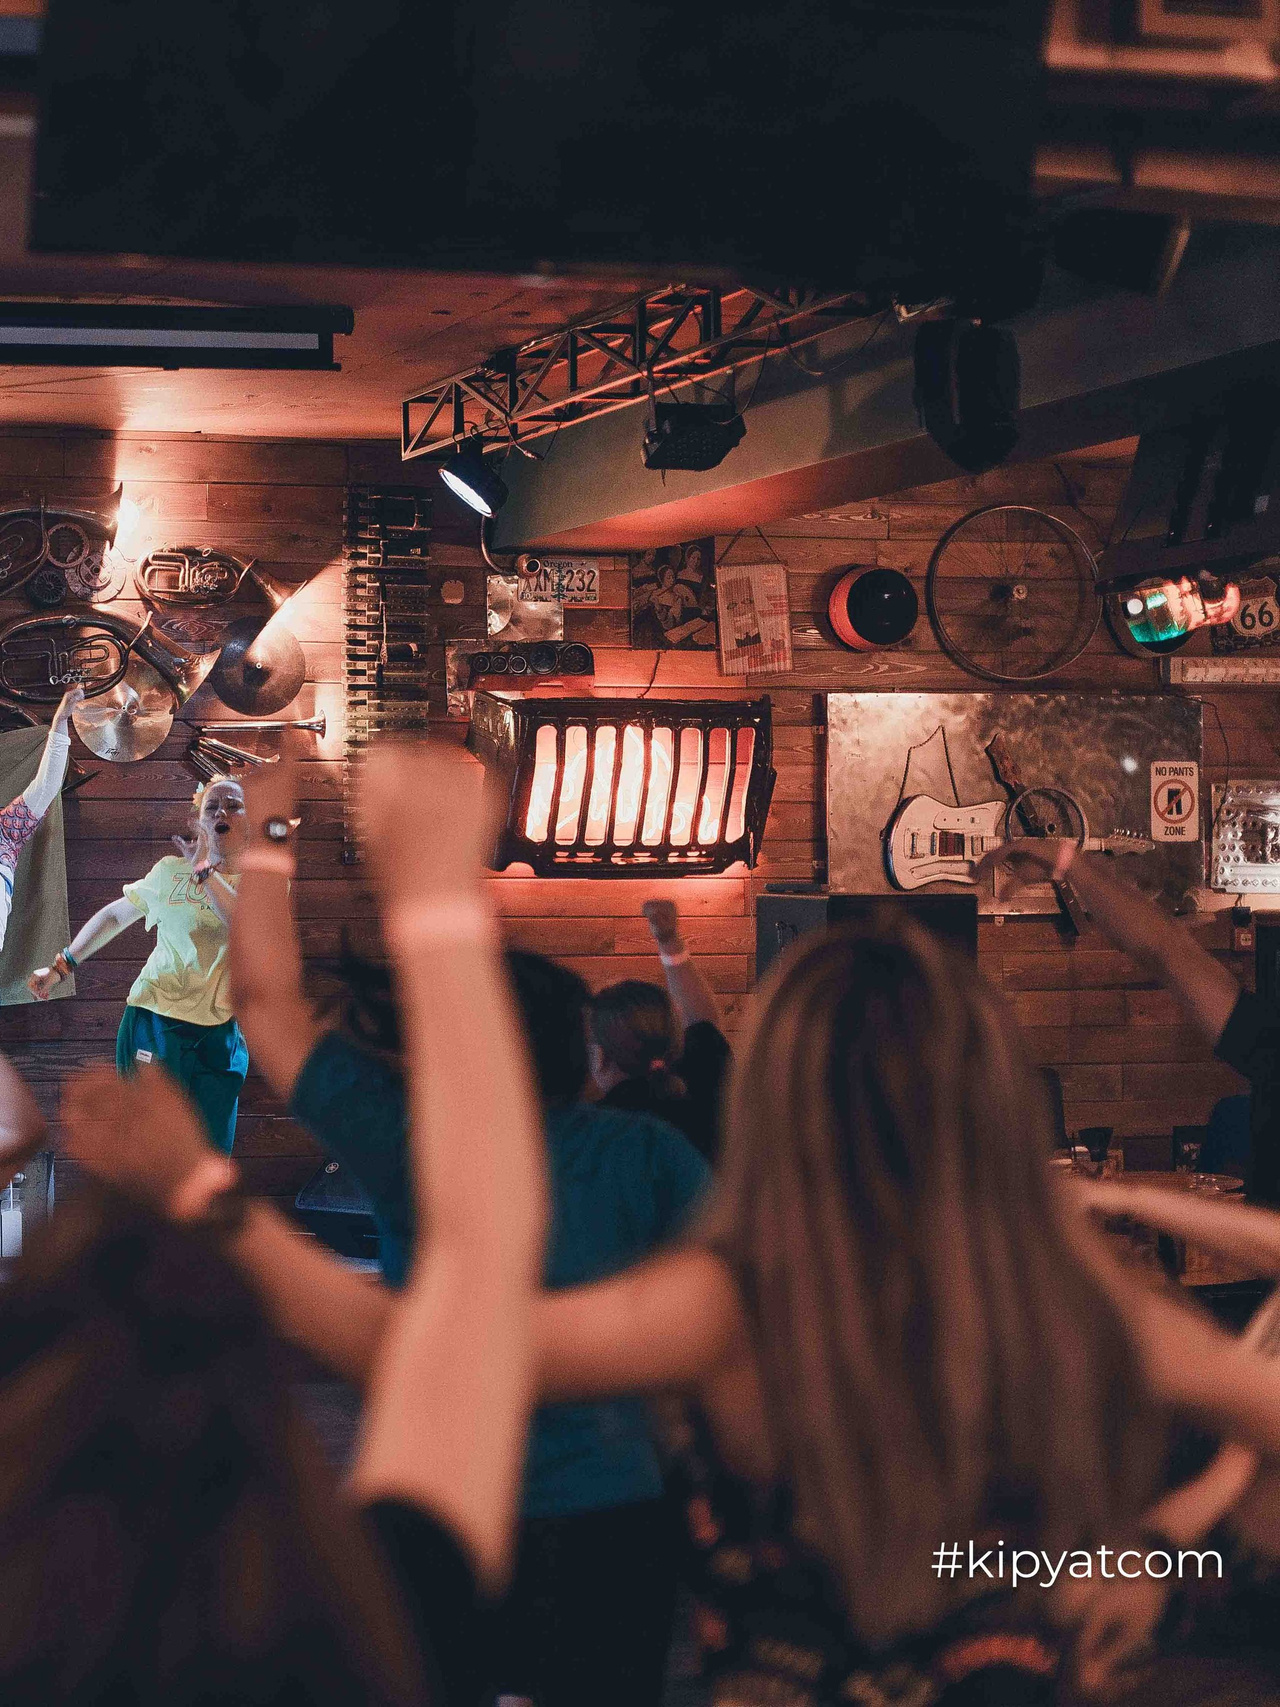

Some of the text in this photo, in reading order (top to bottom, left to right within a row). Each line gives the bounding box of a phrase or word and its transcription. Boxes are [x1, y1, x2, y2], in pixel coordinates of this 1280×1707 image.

[543, 560, 573, 569] Oregon
[566, 569, 596, 592] 232
[1241, 601, 1274, 630] 66
[1155, 766, 1194, 776] NO PANTS
[1164, 826, 1186, 836] ZONE
